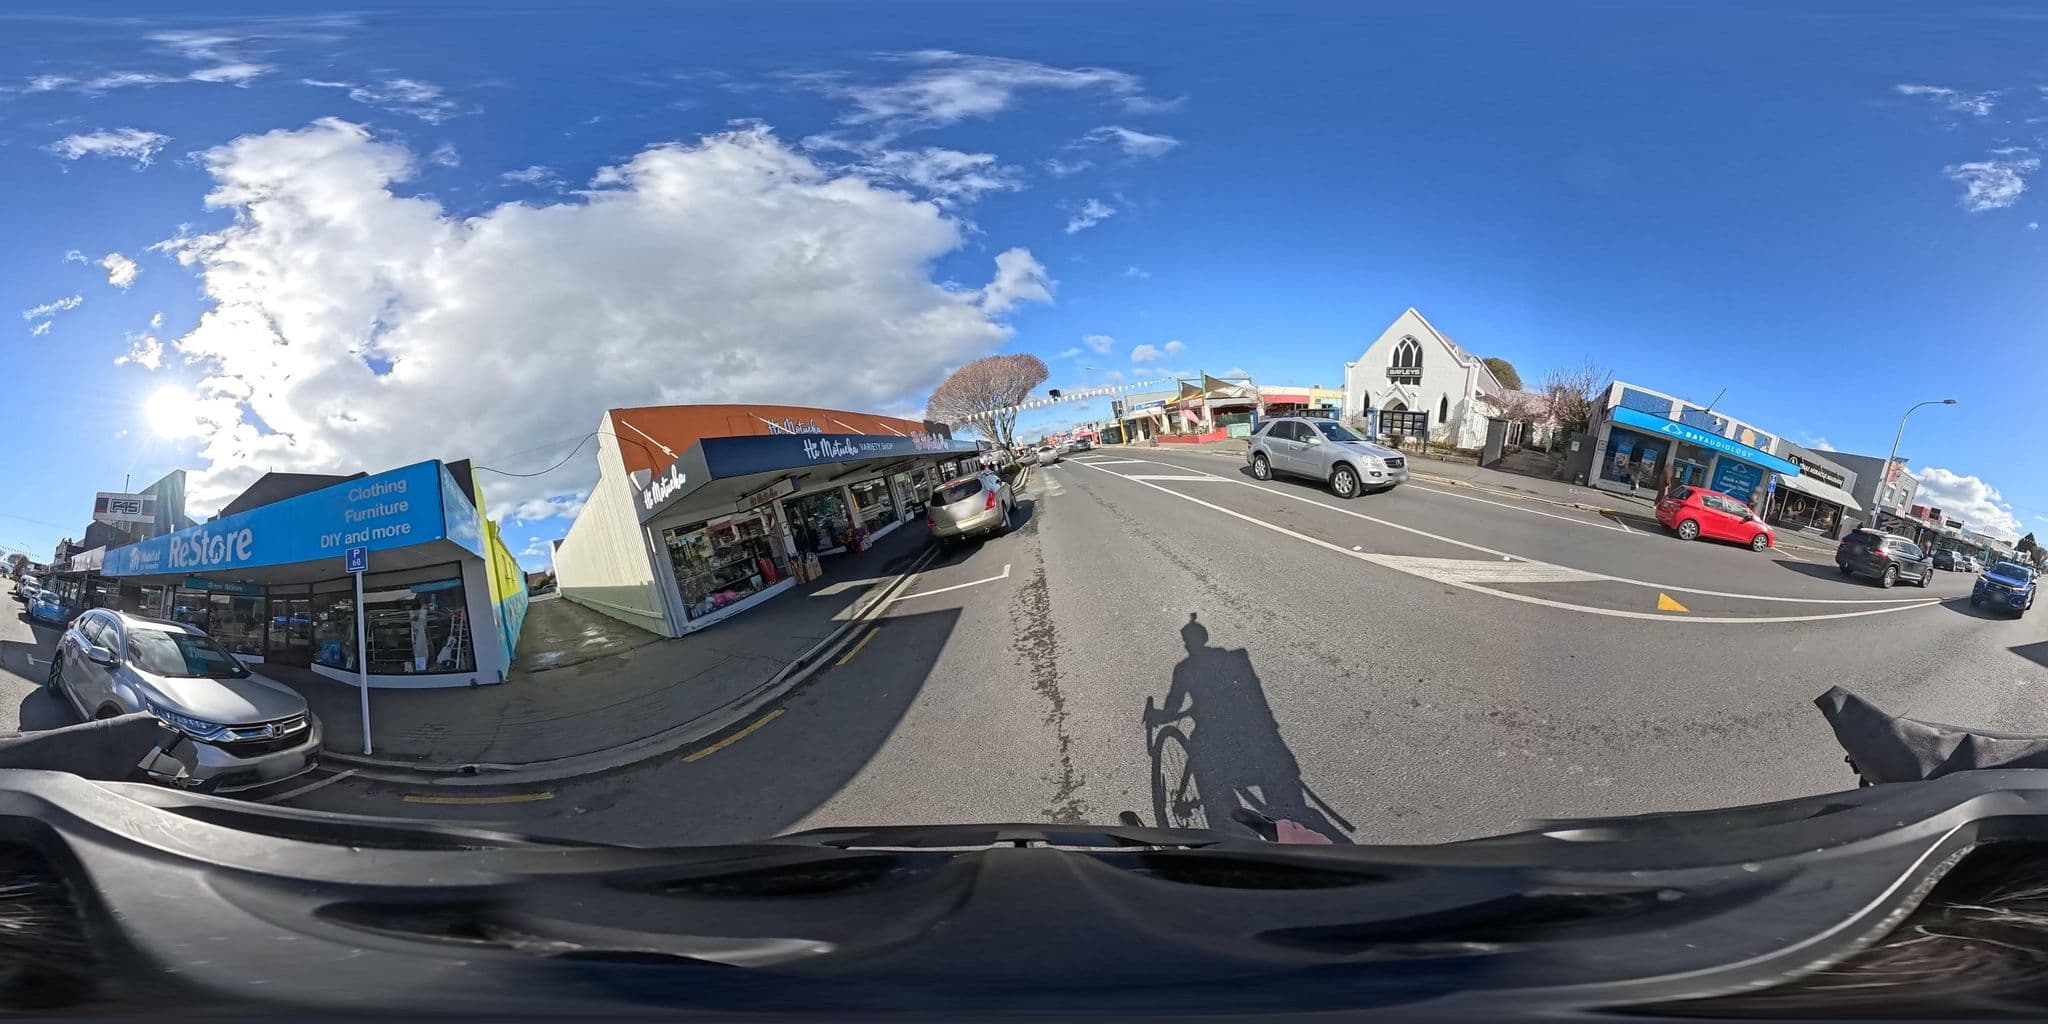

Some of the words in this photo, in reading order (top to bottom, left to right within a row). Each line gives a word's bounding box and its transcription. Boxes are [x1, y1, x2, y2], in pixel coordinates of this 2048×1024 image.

[804, 439, 820, 459] Hi
[821, 438, 858, 458] Motueka
[859, 442, 880, 451] VARIETY
[882, 442, 893, 450] SHOP
[348, 479, 407, 502] Clothing
[652, 464, 686, 504] Motueka
[110, 499, 140, 514] F45
[345, 501, 409, 523] Furniture
[320, 533, 342, 548] DIY
[344, 527, 369, 544] and
[372, 522, 411, 540] more
[168, 528, 253, 568] ReStore
[353, 549, 360, 558] P
[352, 558, 361, 566] 60
